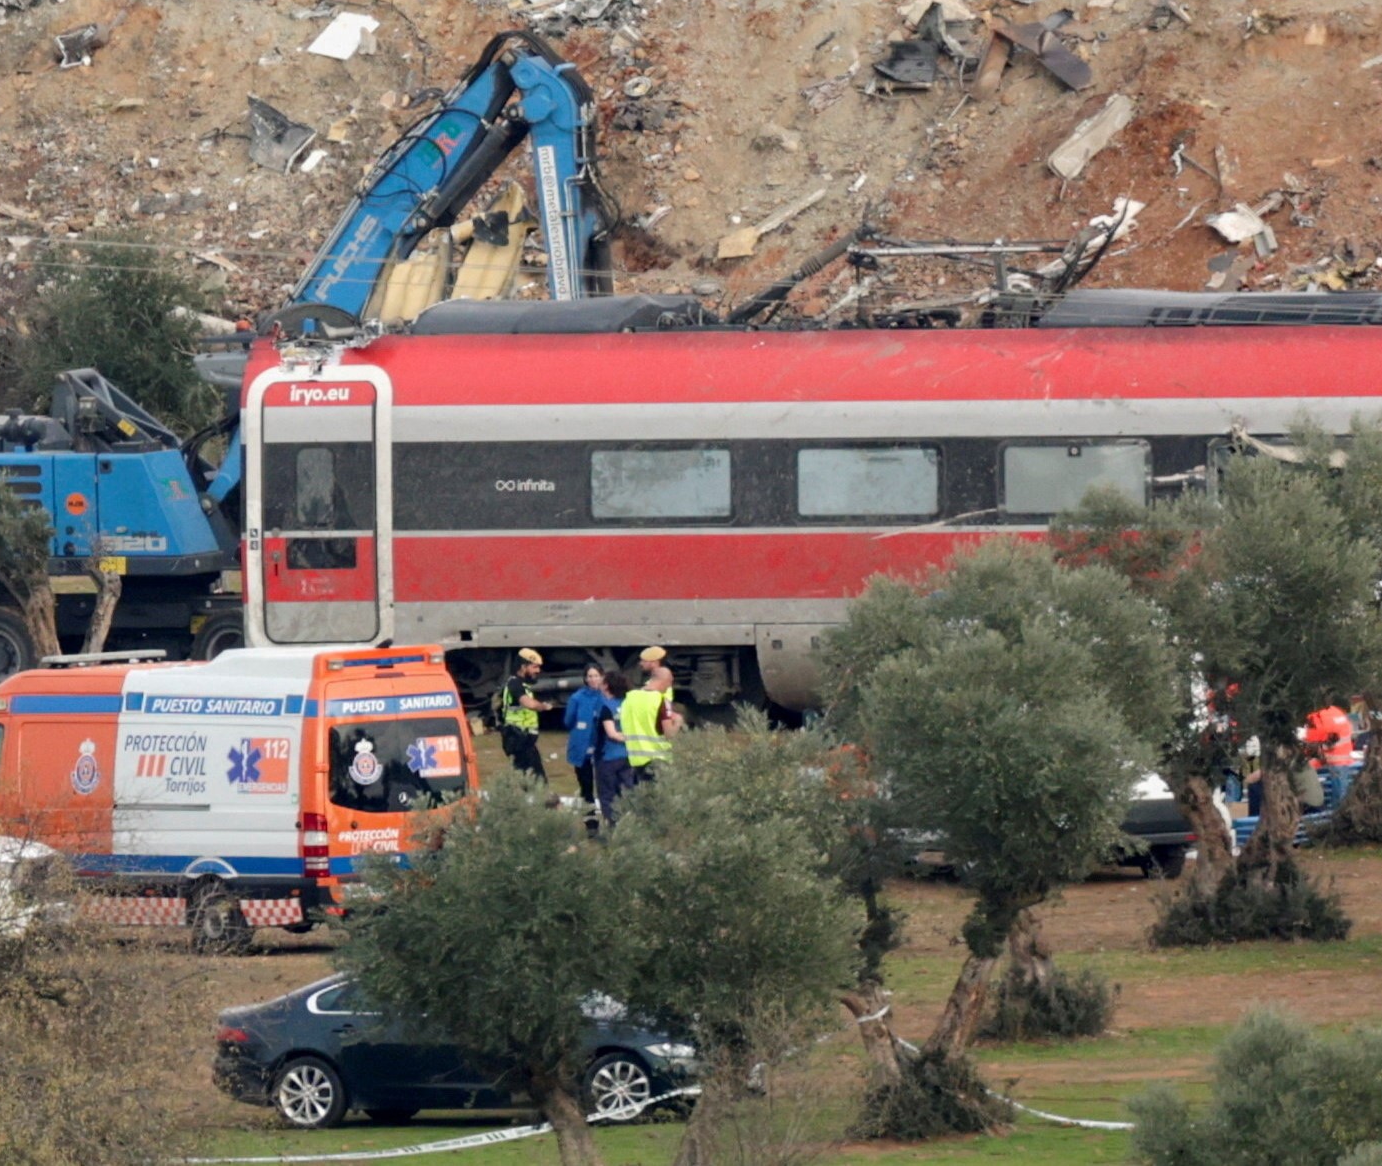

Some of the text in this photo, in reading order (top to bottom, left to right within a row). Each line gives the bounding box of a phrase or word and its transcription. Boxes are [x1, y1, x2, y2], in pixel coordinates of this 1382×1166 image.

[316, 215, 379, 301] FUCHS
[290, 383, 350, 407] iryo.eu
[517, 478, 556, 492] infinita
[151, 697, 276, 715] PUESTO SANITARIO
[342, 694, 453, 714] PUESTO SANITARIO
[124, 730, 207, 752] PROTECCIÓN
[263, 739, 289, 760] 112
[436, 737, 457, 752] 112
[170, 756, 206, 776] CIVIL
[165, 777, 206, 796] Torrijos
[338, 827, 400, 842] PROTECCIÓN
[373, 839, 400, 851] CIVIL
